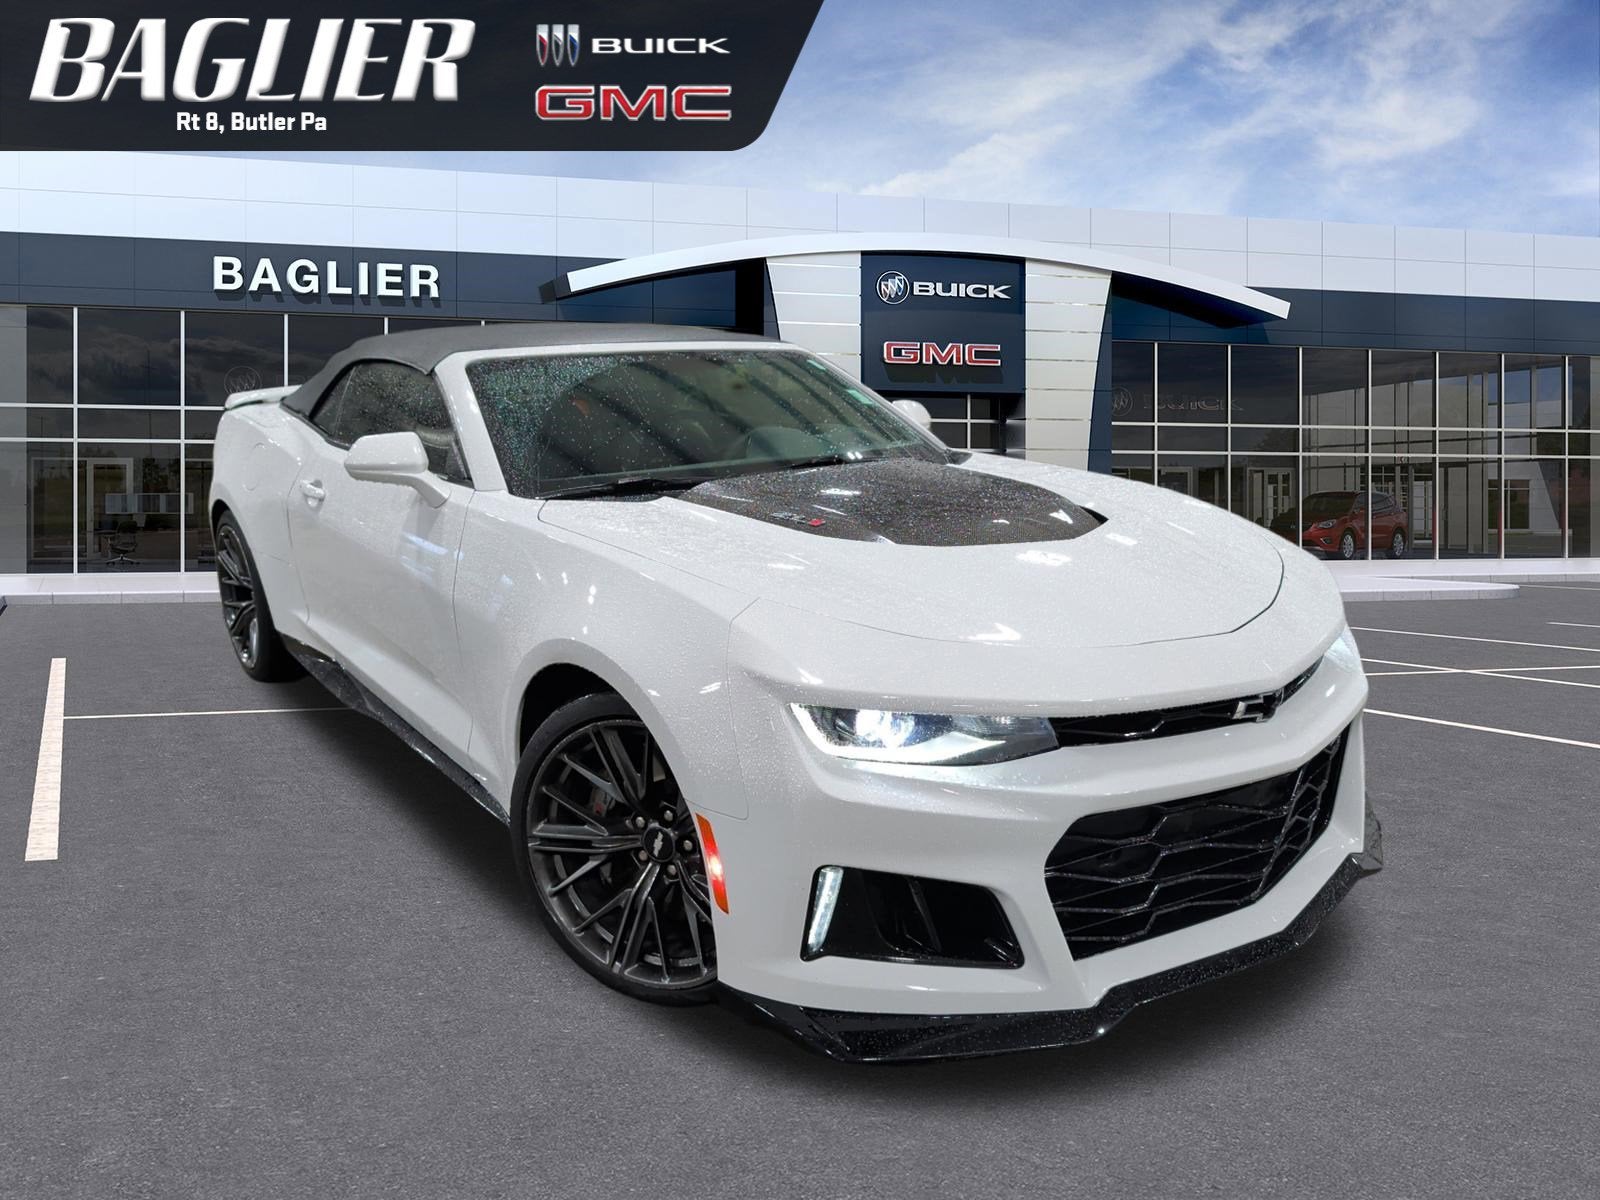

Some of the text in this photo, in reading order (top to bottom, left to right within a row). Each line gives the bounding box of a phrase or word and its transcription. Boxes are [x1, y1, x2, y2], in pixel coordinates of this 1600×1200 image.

[212, 255, 441, 299] BAGLIER
[912, 281, 1011, 299] BUICK
[883, 341, 1001, 366] GMC
